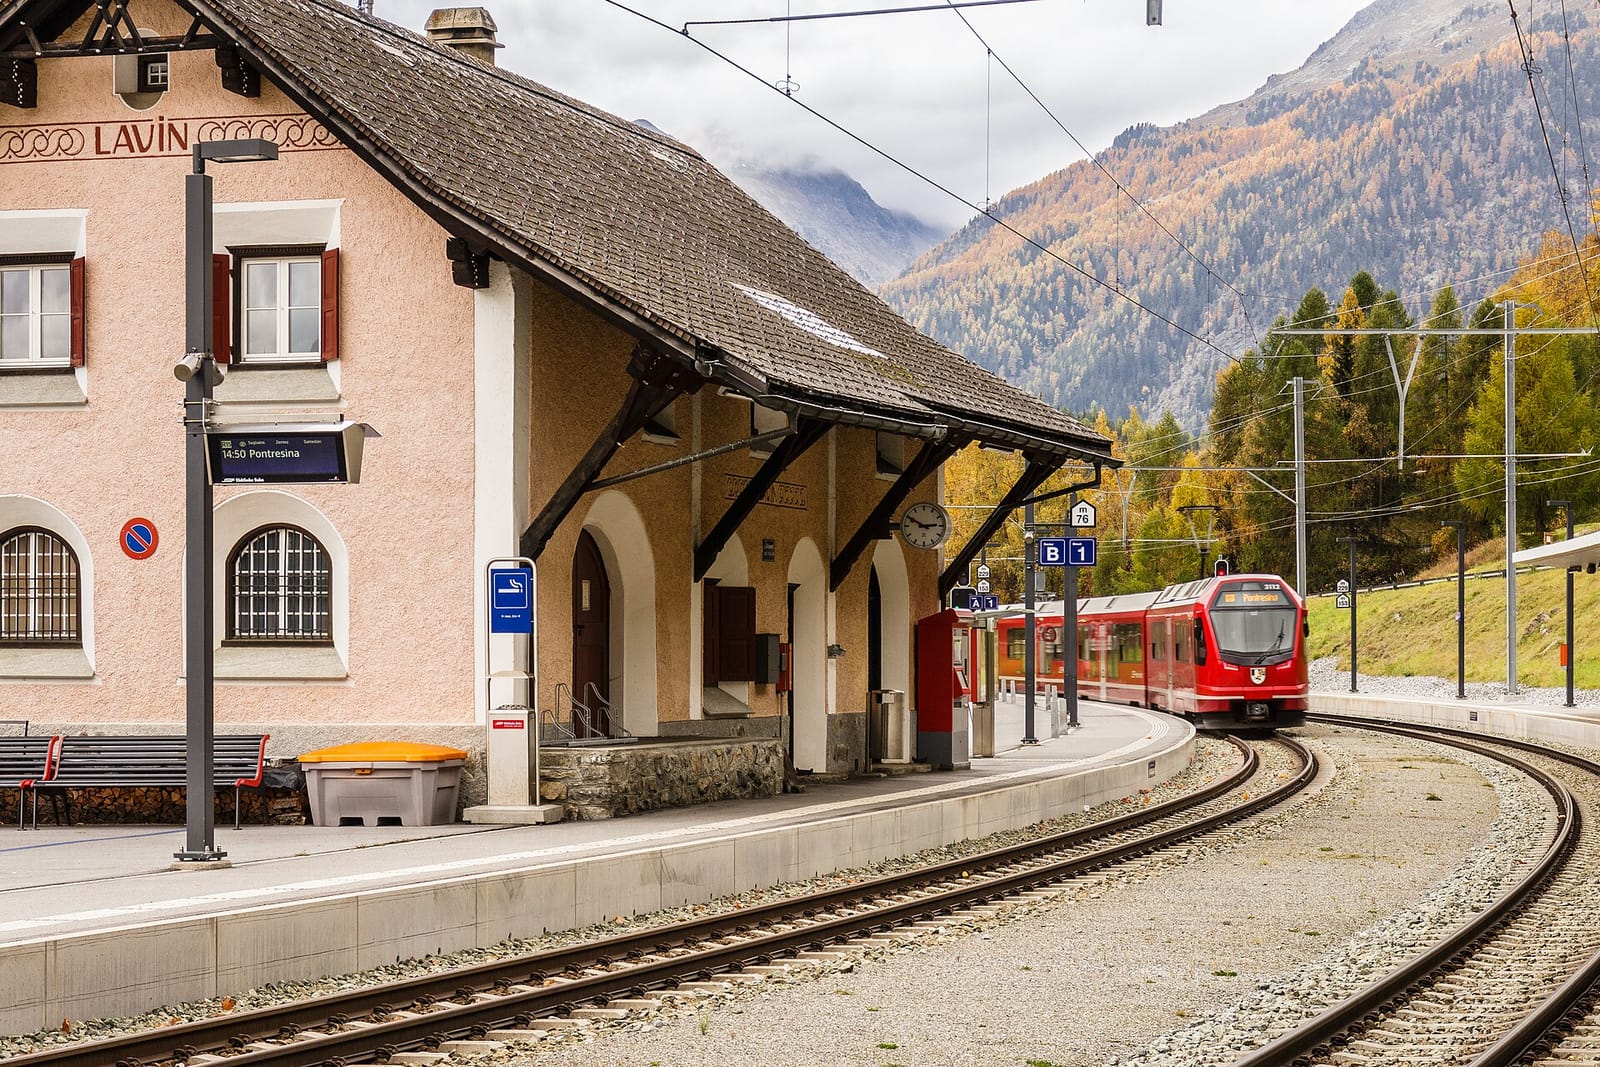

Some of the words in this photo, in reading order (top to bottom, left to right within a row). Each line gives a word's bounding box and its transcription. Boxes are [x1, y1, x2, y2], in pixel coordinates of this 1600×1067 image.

[222, 449, 247, 459] 14:50
[249, 448, 300, 459] Pontresina
[1076, 514, 1089, 524] 76
[1046, 546, 1060, 562] B
[1077, 546, 1085, 562] 1
[1242, 593, 1279, 603] Pontresina
[972, 599, 980, 608] A
[988, 599, 993, 608] 1
